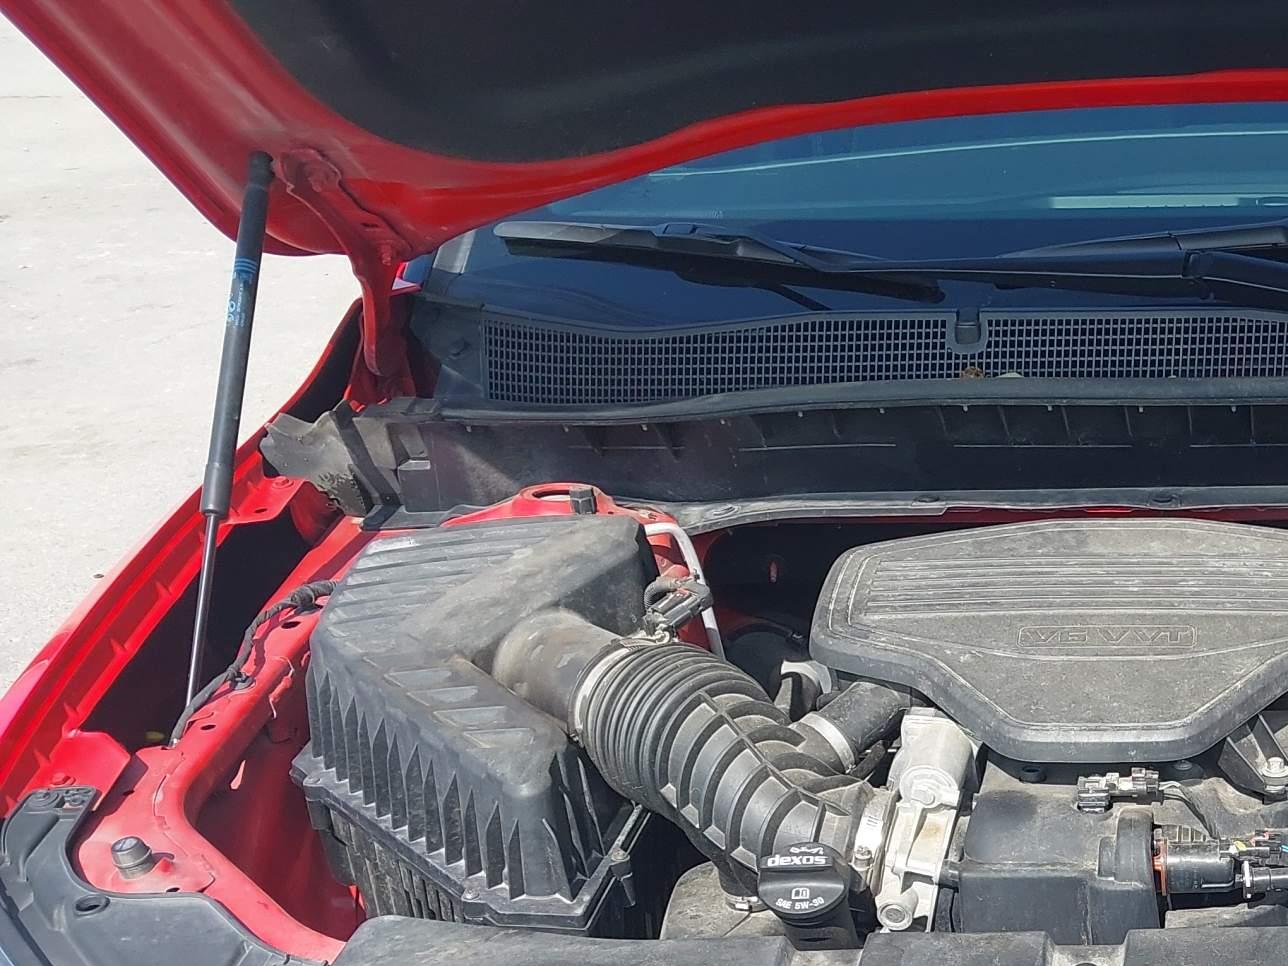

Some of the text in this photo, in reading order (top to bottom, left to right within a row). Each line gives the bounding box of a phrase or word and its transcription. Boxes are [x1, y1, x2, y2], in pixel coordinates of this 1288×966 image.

[1097, 629, 1189, 644] VVT
[767, 854, 829, 867] dexos
[775, 898, 792, 909] SAE
